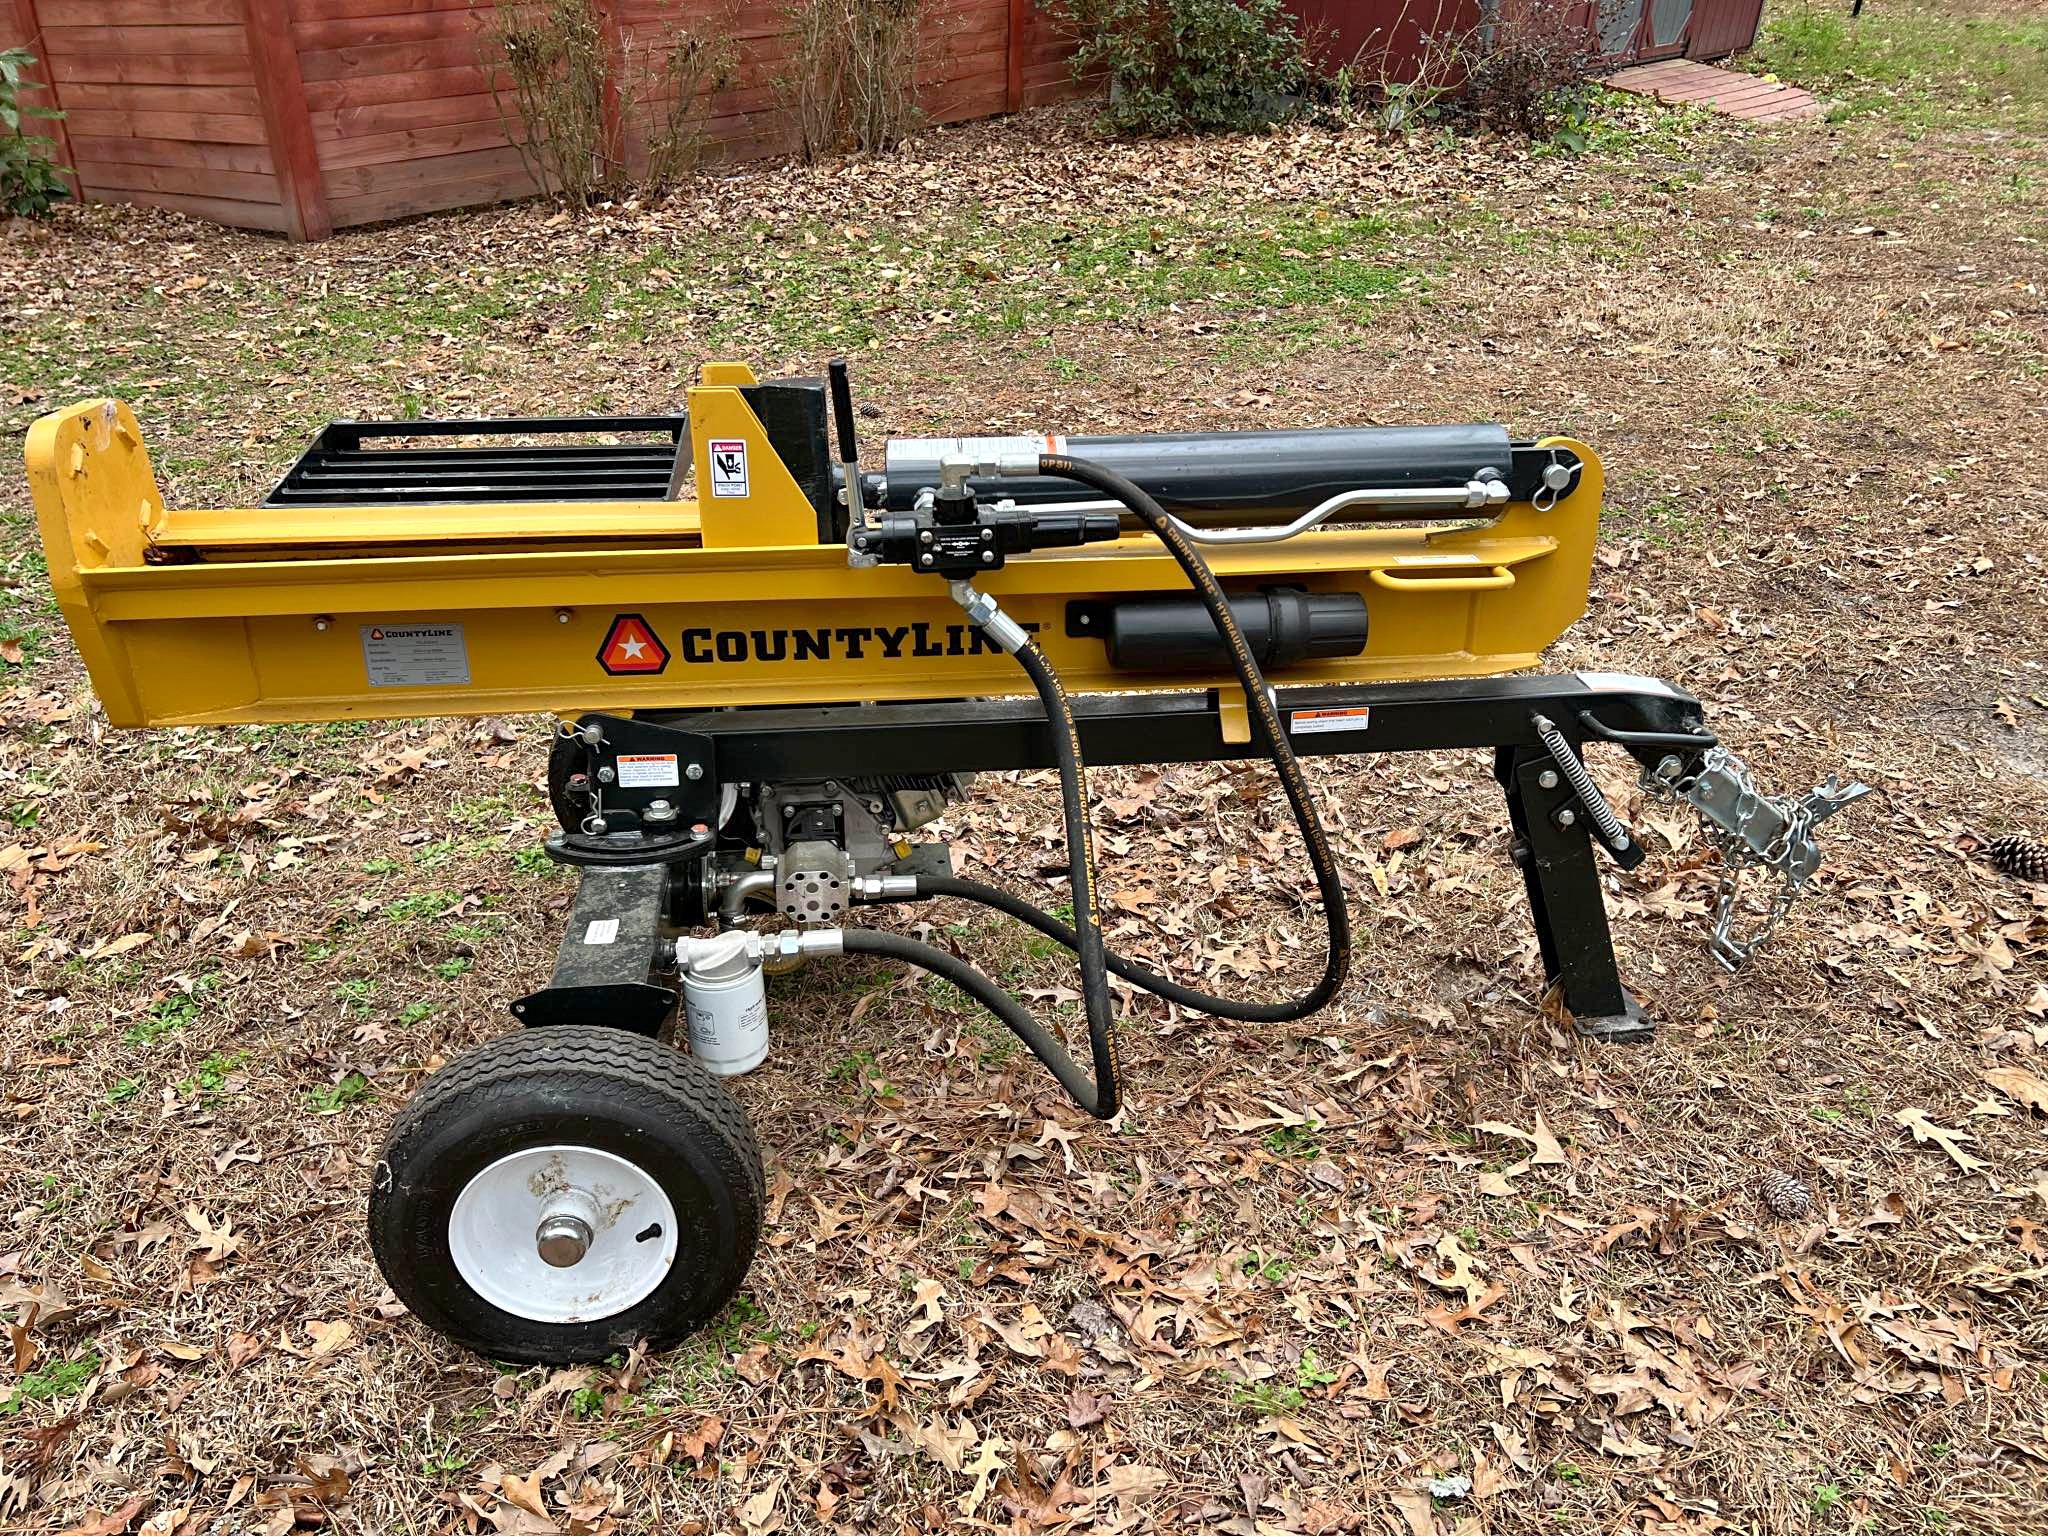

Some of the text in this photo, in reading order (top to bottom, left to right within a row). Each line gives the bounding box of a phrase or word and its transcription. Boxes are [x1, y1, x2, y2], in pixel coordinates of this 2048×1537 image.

[1167, 526, 1215, 594] COUNTYLINE
[1215, 601, 1248, 661] HYDRAULIC
[1244, 662, 1261, 692] HOSE
[385, 629, 454, 639] COUNTYLINE
[1069, 727, 1081, 757] HOSE
[1076, 761, 1089, 823] HYDRAULIC
